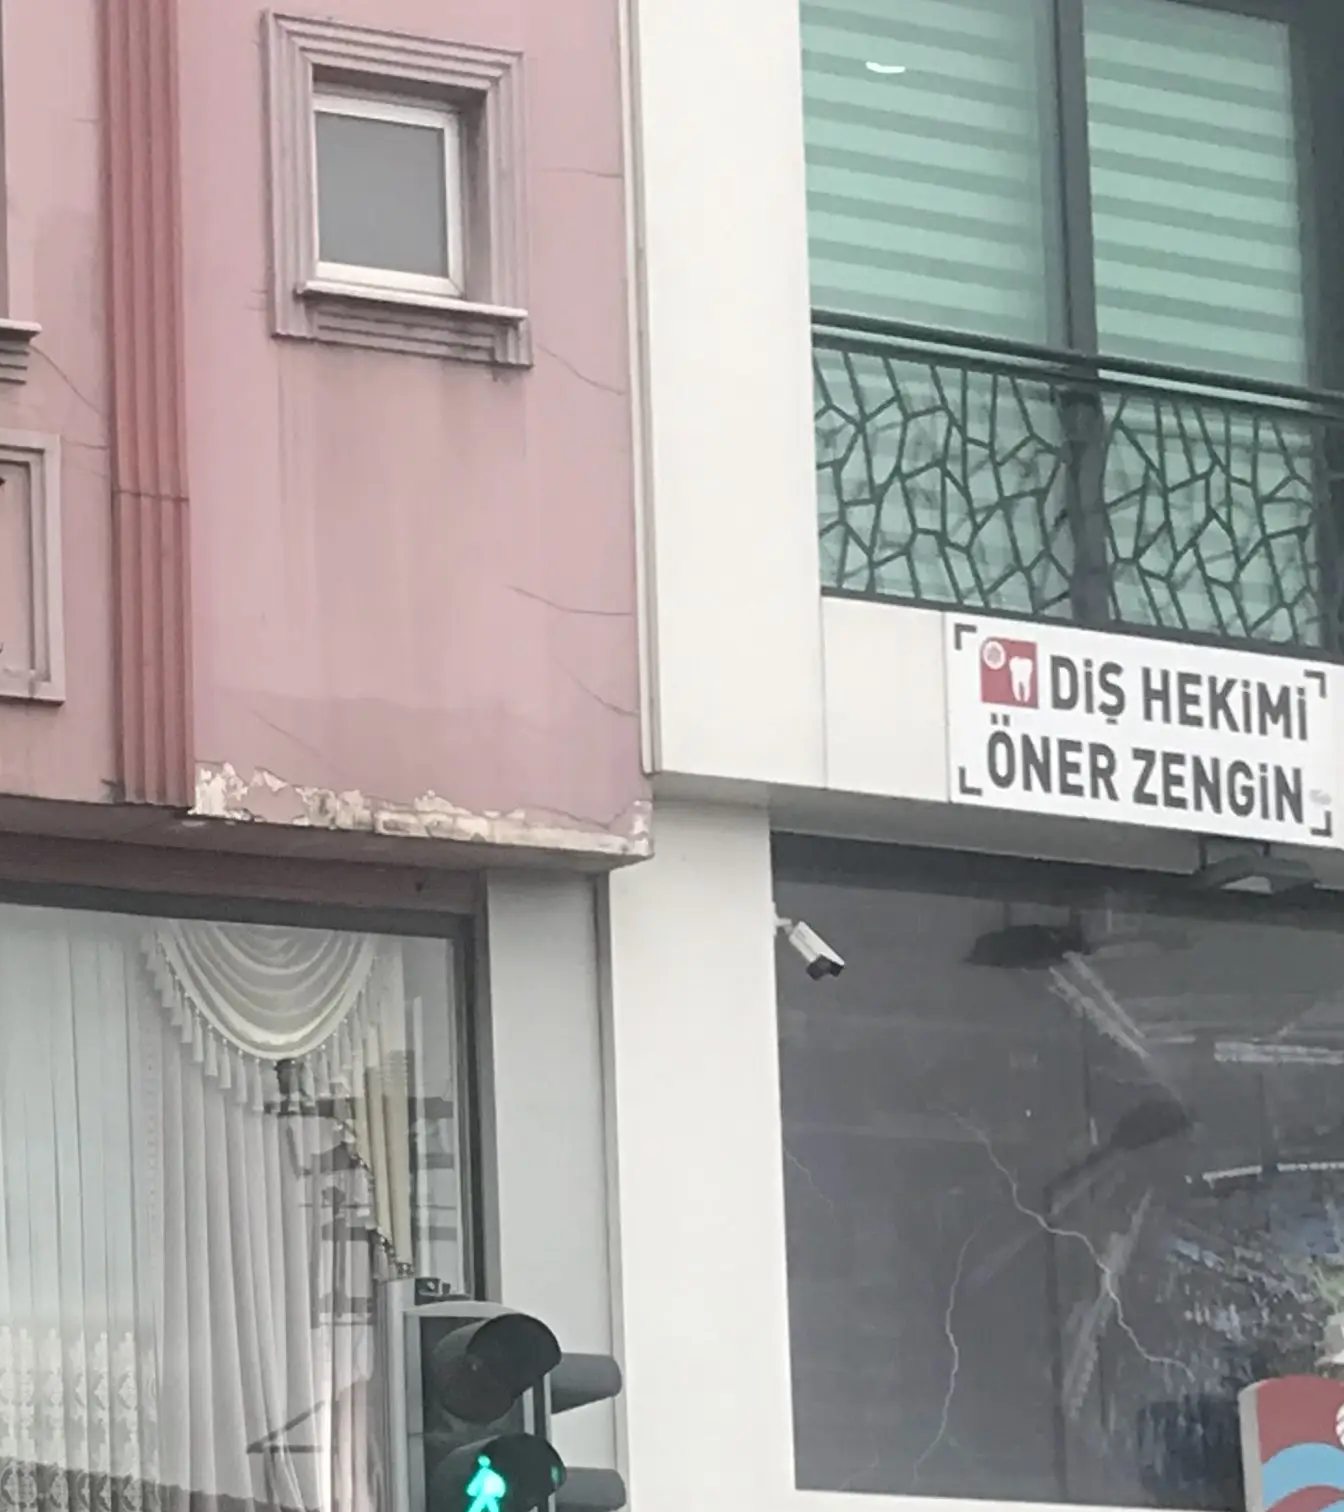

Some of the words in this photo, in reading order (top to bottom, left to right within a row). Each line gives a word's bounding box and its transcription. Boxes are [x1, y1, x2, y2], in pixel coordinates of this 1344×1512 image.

[1050, 654, 1126, 725] DİŞ
[1141, 666, 1308, 741] HEKİMİ
[986, 713, 1120, 802] ÖNER
[1132, 746, 1304, 825] ZENGİN
